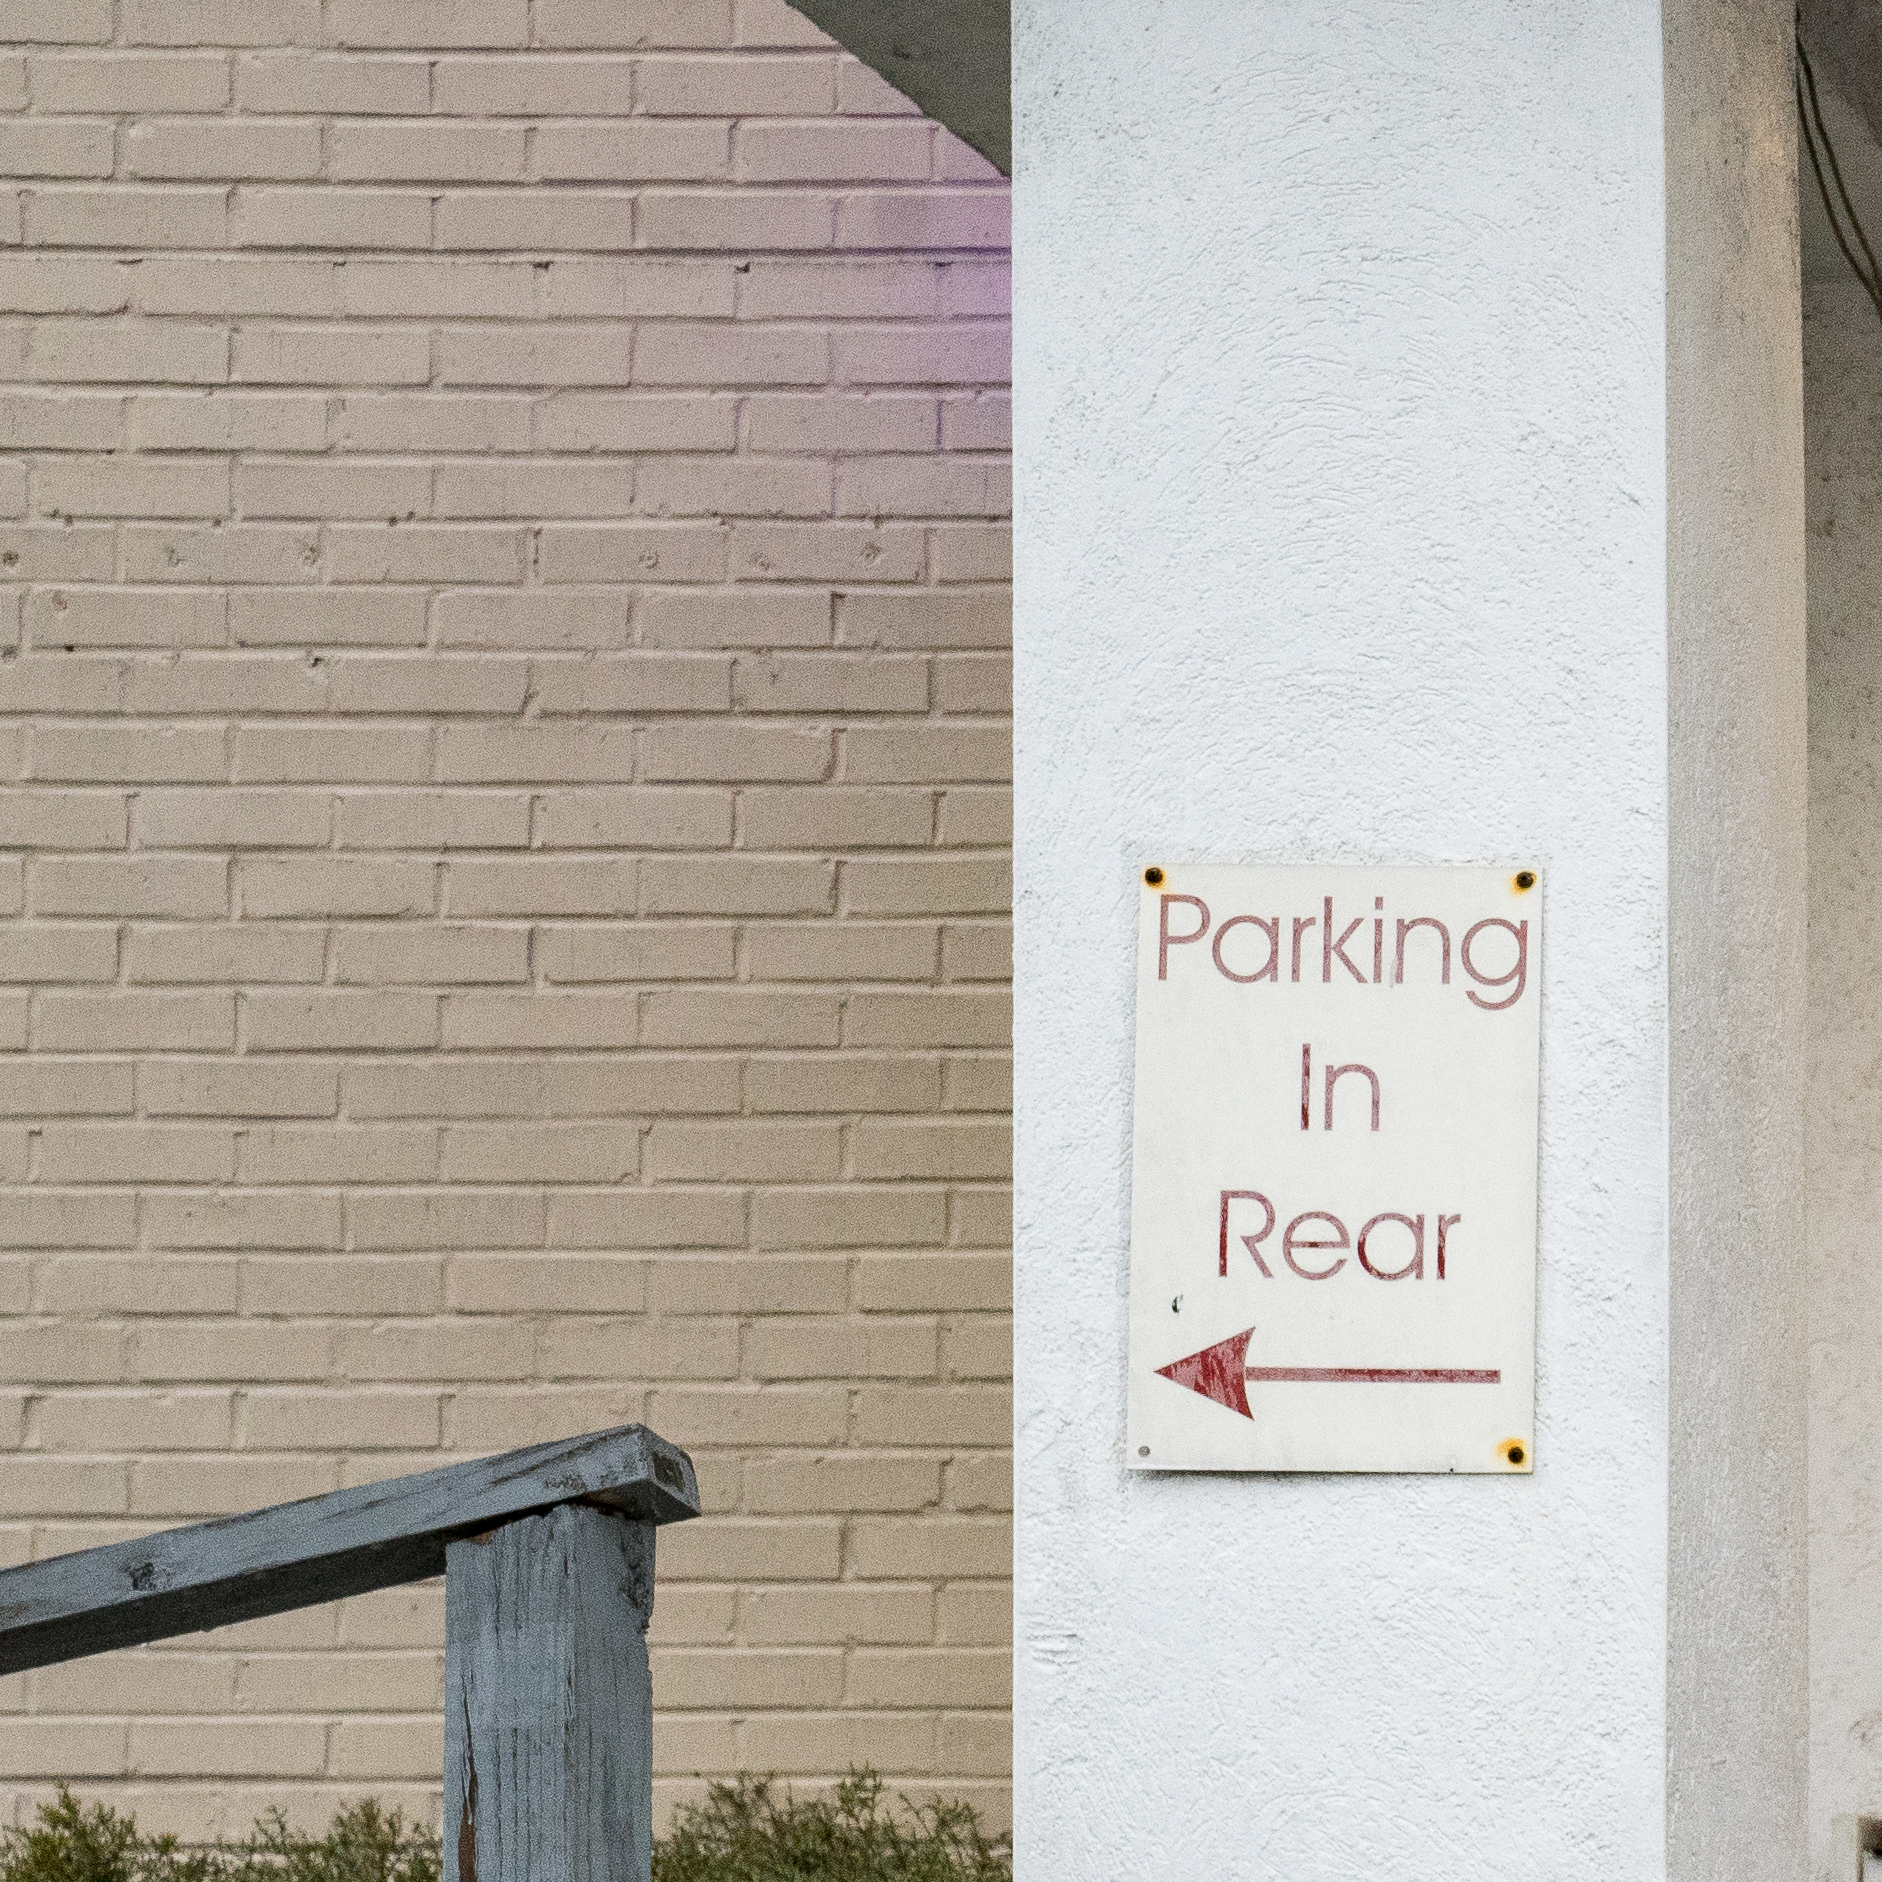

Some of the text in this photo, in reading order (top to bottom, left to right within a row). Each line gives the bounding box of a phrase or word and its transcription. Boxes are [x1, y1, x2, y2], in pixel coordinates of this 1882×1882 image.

[1157, 893, 1530, 1011] Parking
[1300, 1043, 1381, 1132] In
[1217, 1189, 1462, 1281] Rear
